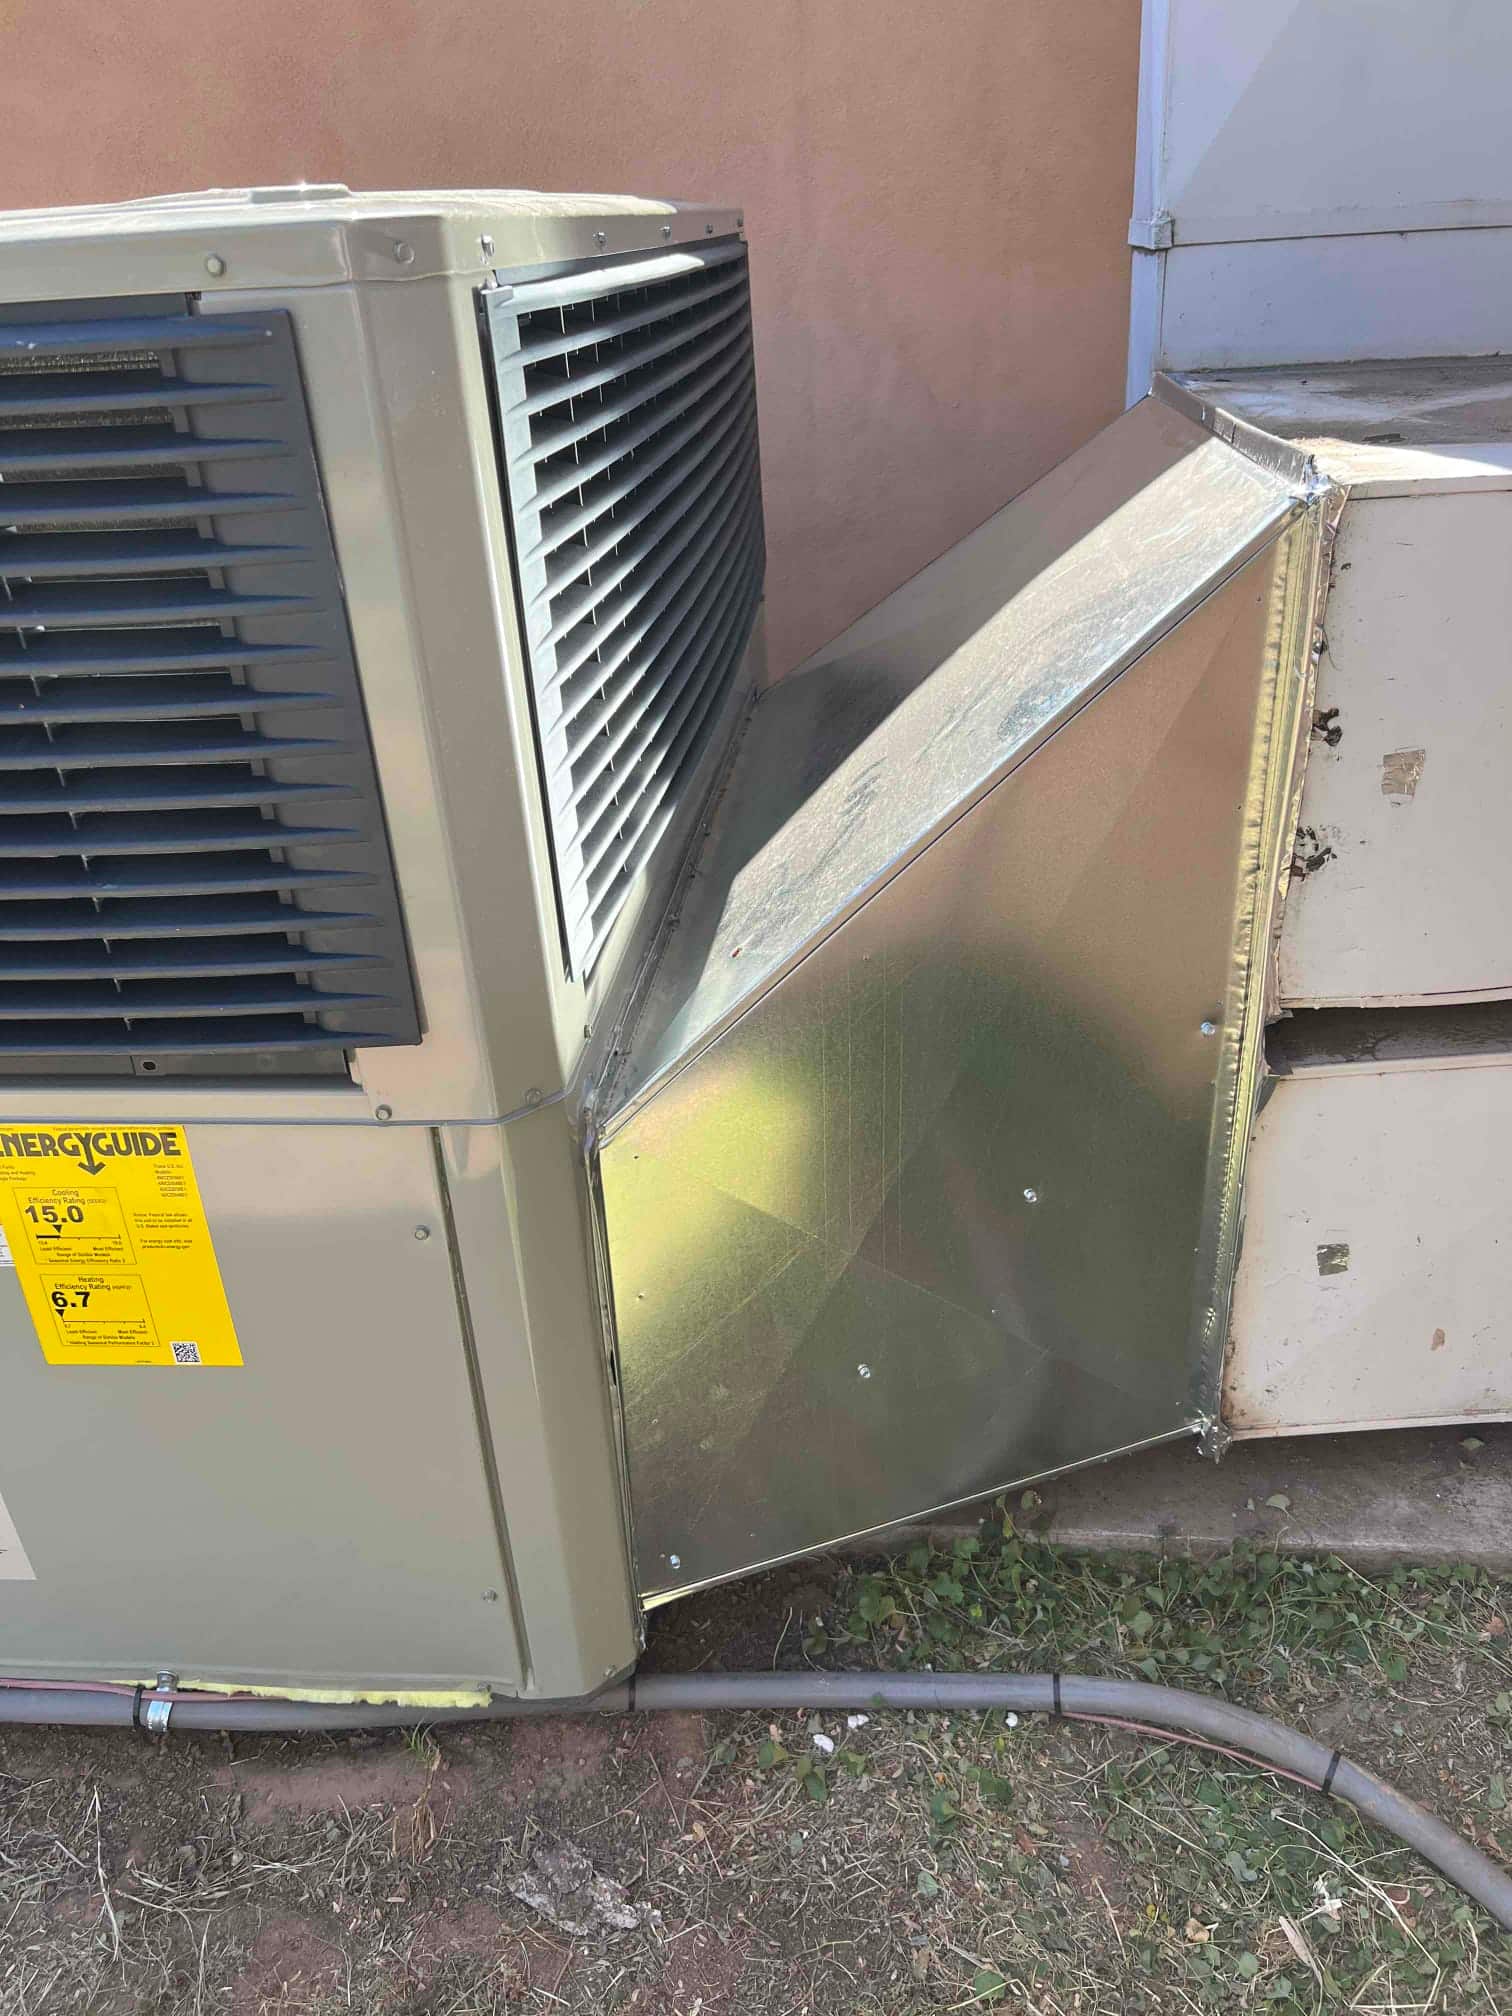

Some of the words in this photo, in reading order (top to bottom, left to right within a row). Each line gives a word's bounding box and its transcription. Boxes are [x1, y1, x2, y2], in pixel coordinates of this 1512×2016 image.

[52, 1189, 80, 1197] Cooling
[28, 1197, 61, 1205] Efficiency
[63, 1197, 86, 1205] Rating
[25, 1204, 84, 1223] 15.0
[78, 1276, 105, 1284] Heating
[54, 1283, 88, 1291] Efficiency
[88, 1283, 111, 1292] Rating
[51, 1291, 91, 1308] 6.7
